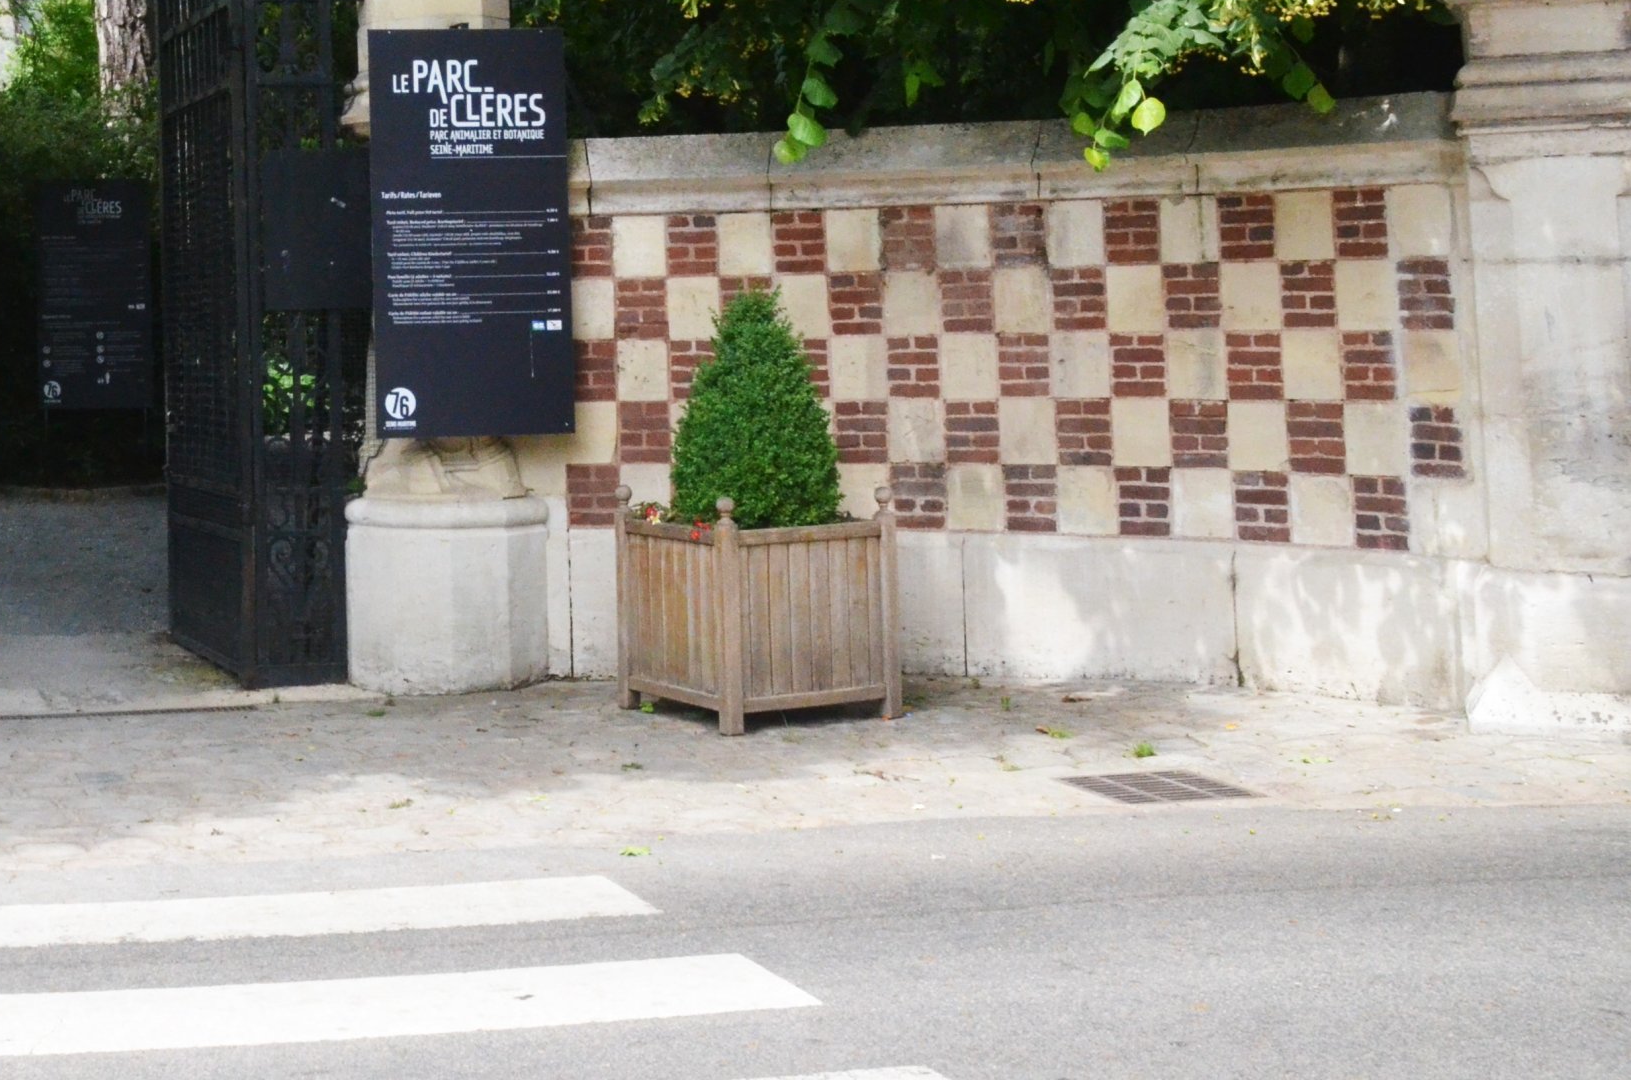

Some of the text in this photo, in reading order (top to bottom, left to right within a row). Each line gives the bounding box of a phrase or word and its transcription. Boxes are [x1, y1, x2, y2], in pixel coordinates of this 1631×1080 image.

[392, 59, 483, 105] LE PARC
[429, 108, 448, 128] DE
[430, 129, 545, 143] PARC ANIMALIER ET BOTANIQUE
[430, 141, 494, 158] SEINE-MARITIME
[387, 391, 410, 420] 76
